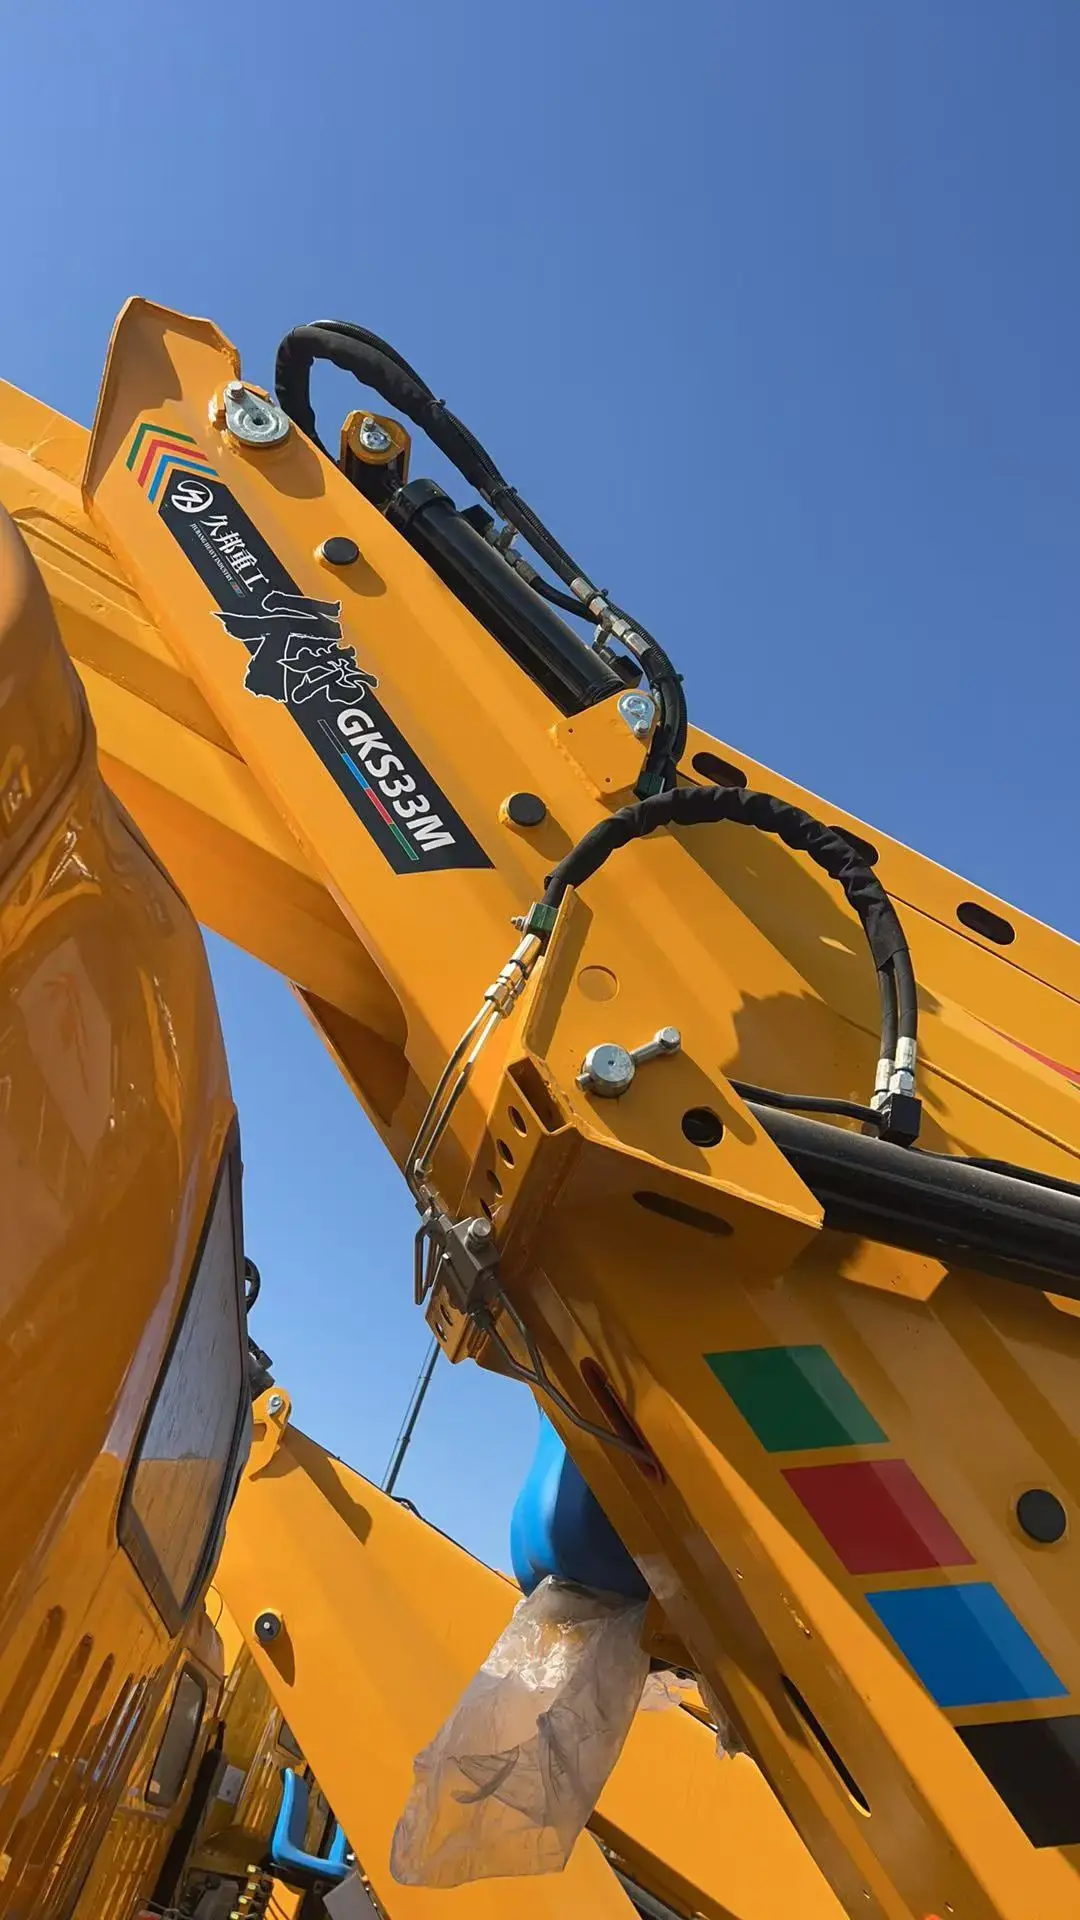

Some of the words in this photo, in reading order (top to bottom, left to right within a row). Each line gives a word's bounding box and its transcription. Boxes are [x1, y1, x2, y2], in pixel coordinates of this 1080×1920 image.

[200, 515, 269, 592] 久邦重工
[203, 542, 218, 559] HEAVY
[214, 557, 234, 581] INDUSTRY
[337, 708, 456, 851] GKS33M
